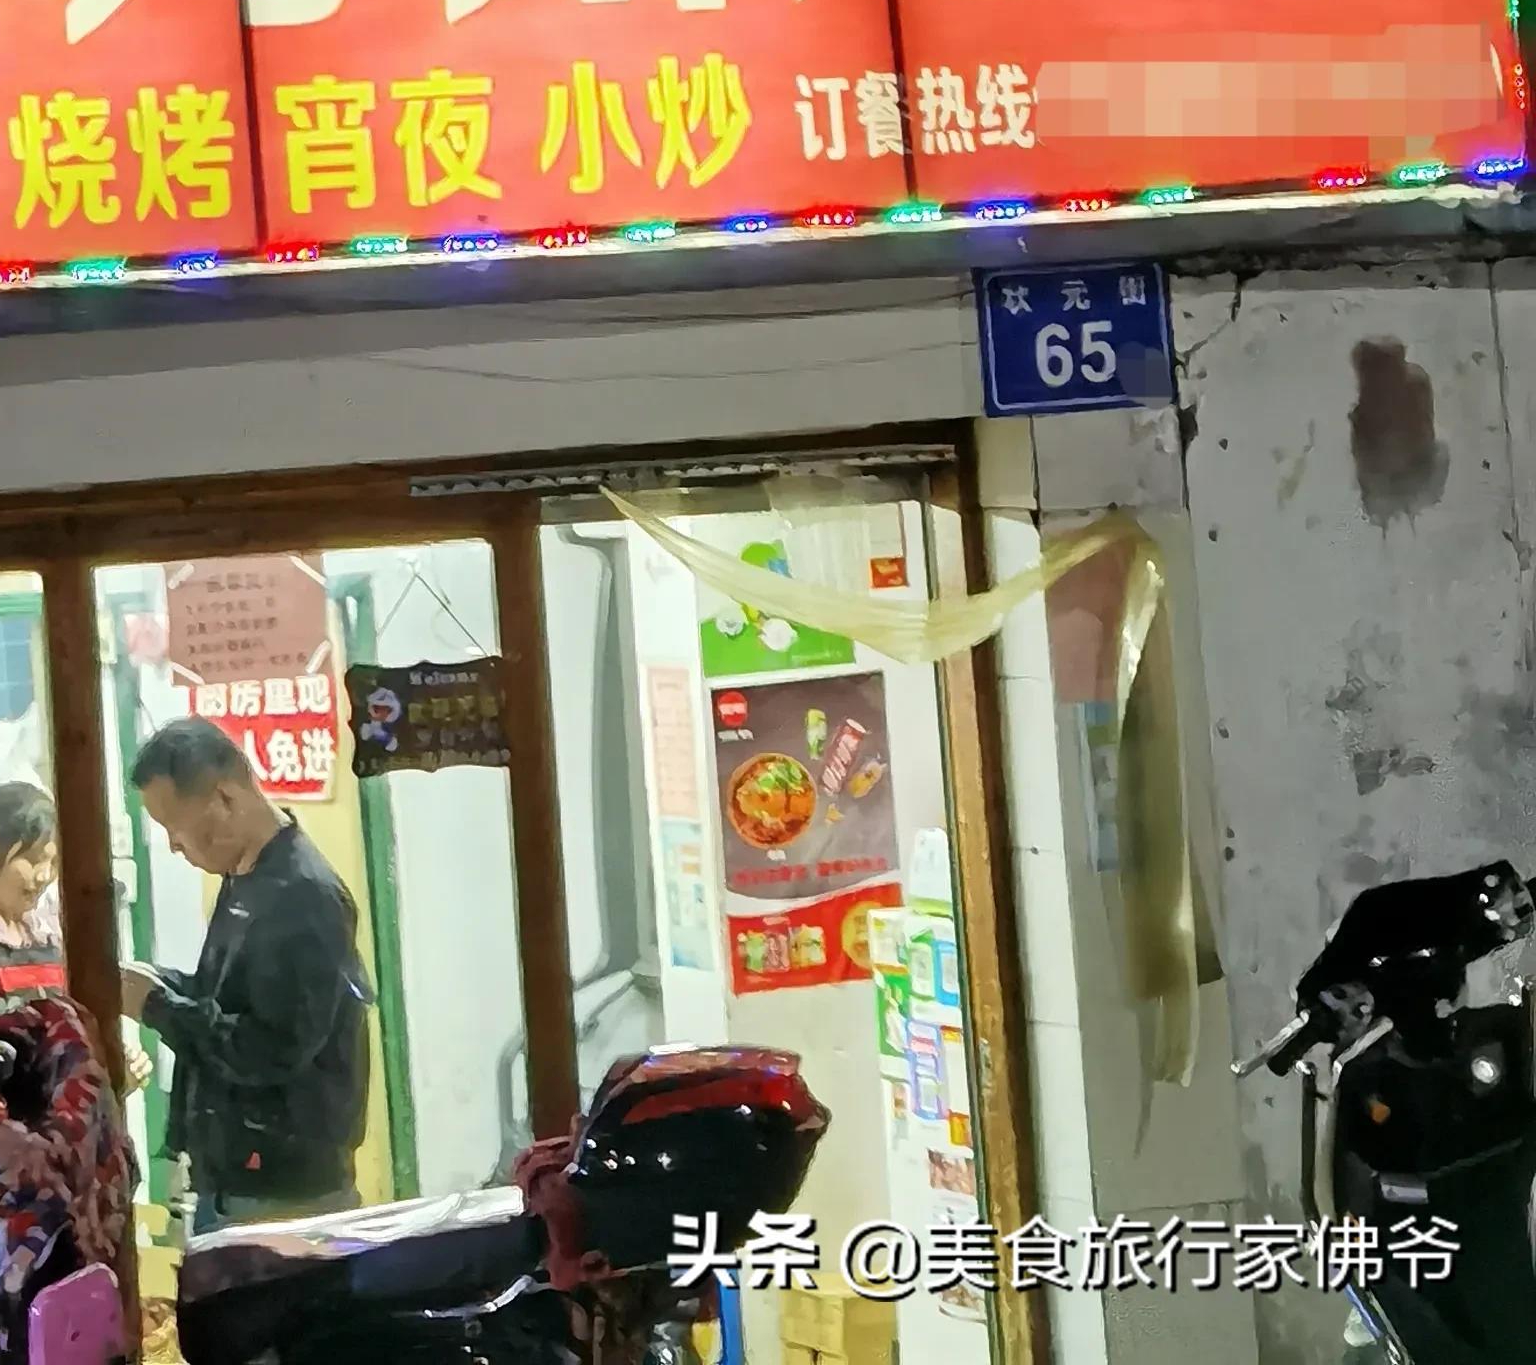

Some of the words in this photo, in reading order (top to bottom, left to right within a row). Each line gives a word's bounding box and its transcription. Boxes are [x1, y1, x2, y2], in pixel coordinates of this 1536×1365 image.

[7, 83, 236, 230] 烧烤
[275, 67, 502, 215] 宵夜
[540, 52, 754, 194] 小炒
[794, 64, 1036, 161] 订餐热线
[1035, 320, 1116, 388] 65
